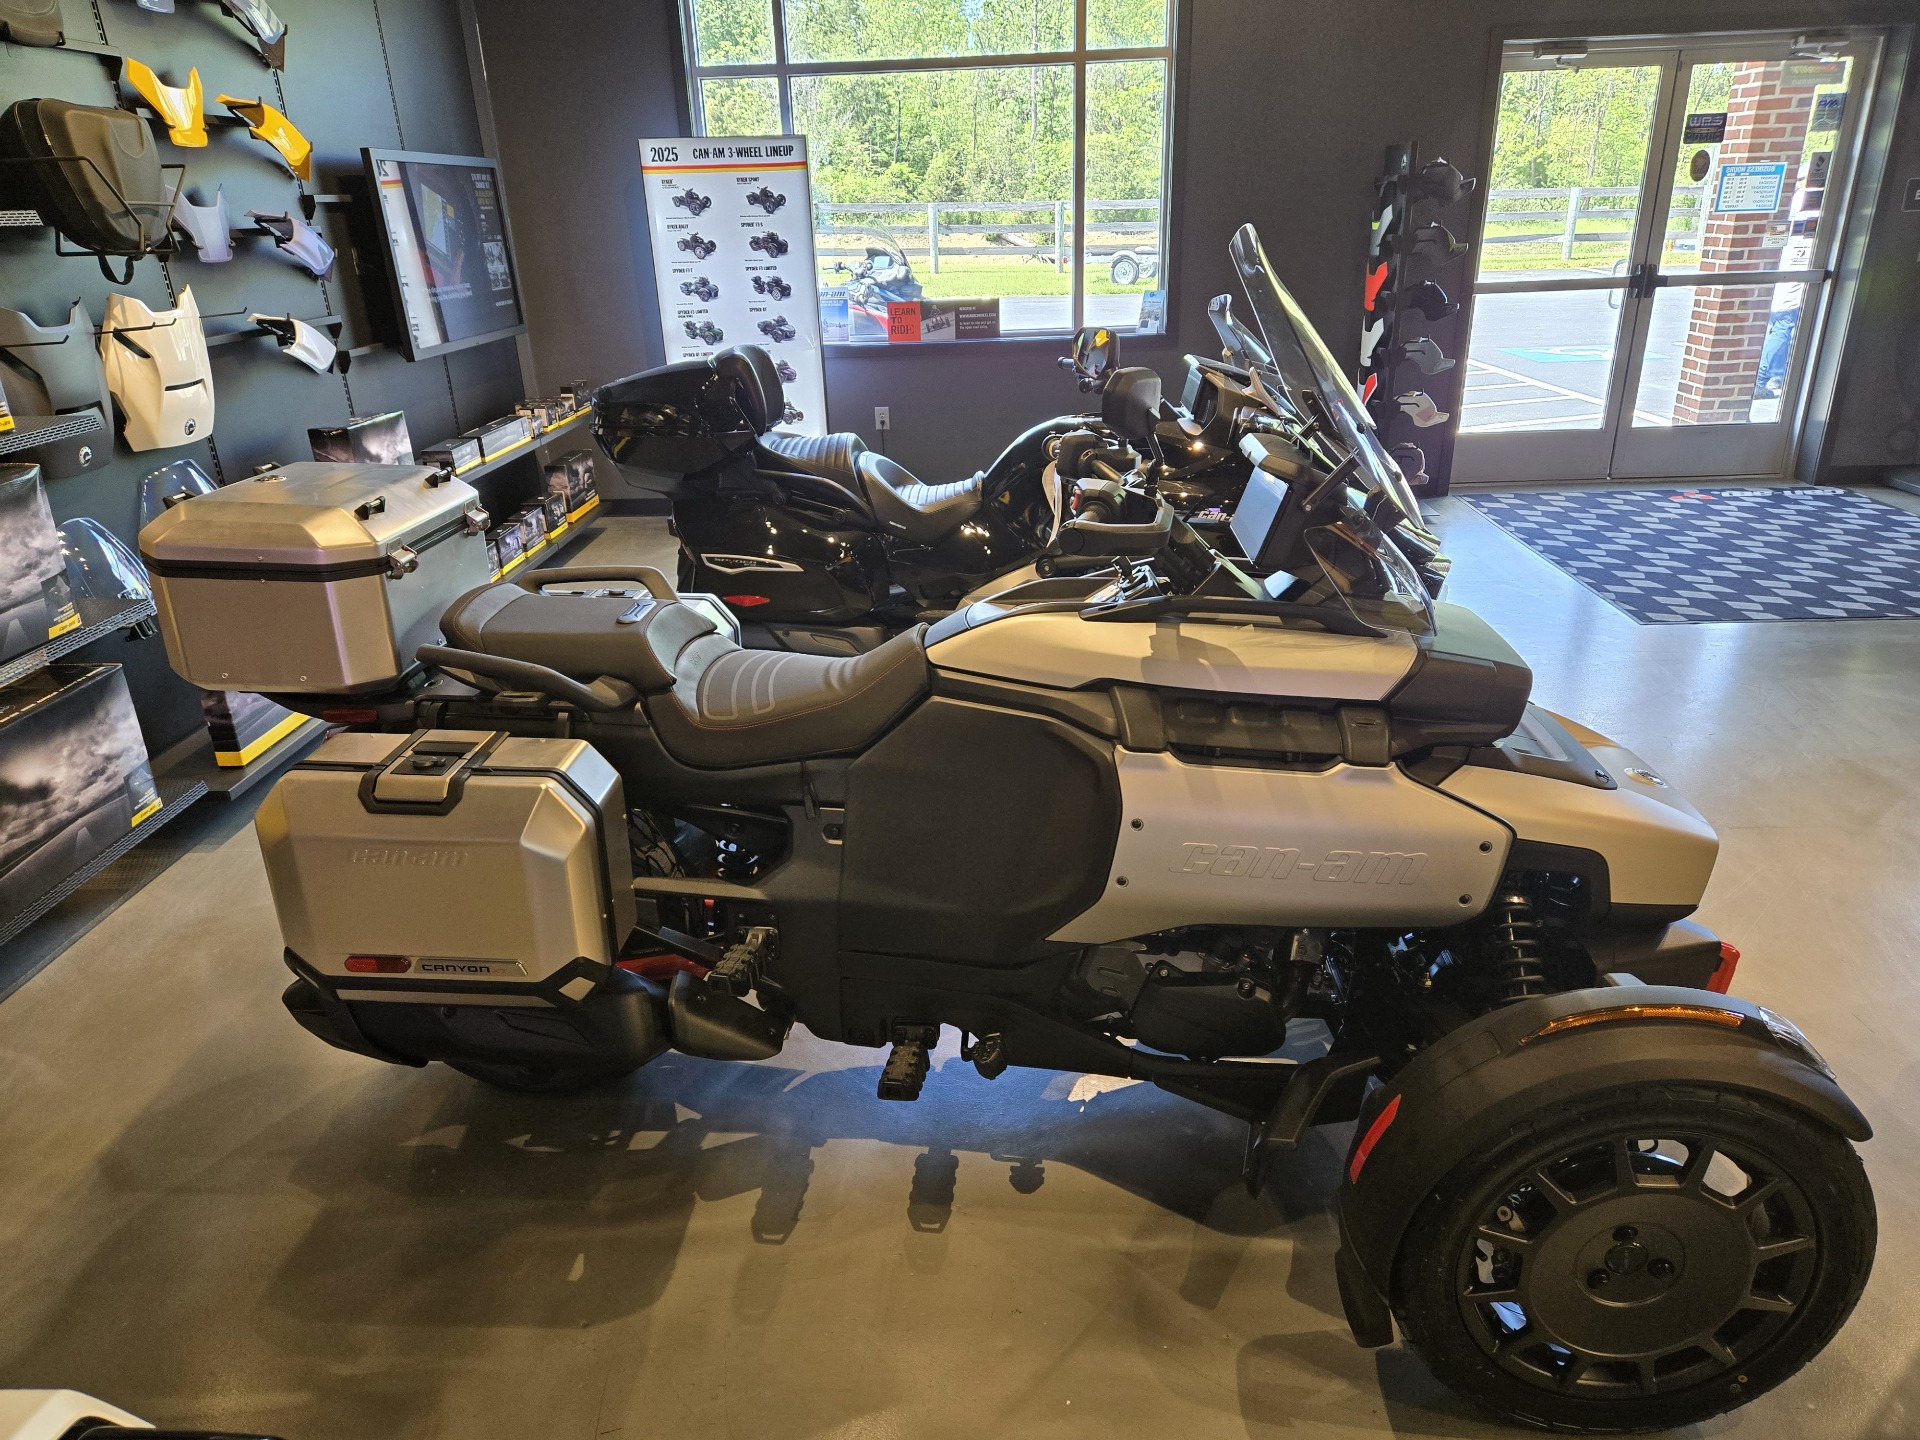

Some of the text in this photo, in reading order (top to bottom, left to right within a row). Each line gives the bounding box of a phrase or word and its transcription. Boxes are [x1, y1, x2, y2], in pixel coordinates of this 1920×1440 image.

[650, 145, 794, 162] 2025 CAN-AM 3-WHEEL LINEUP
[890, 307, 916, 316] LEARN
[891, 316, 903, 325] TO
[890, 325, 915, 335] RIDE
[1197, 510, 1234, 522] can-
[352, 850, 469, 866] can-am
[1168, 842, 1429, 885] can-am
[421, 963, 491, 974] CANYON
